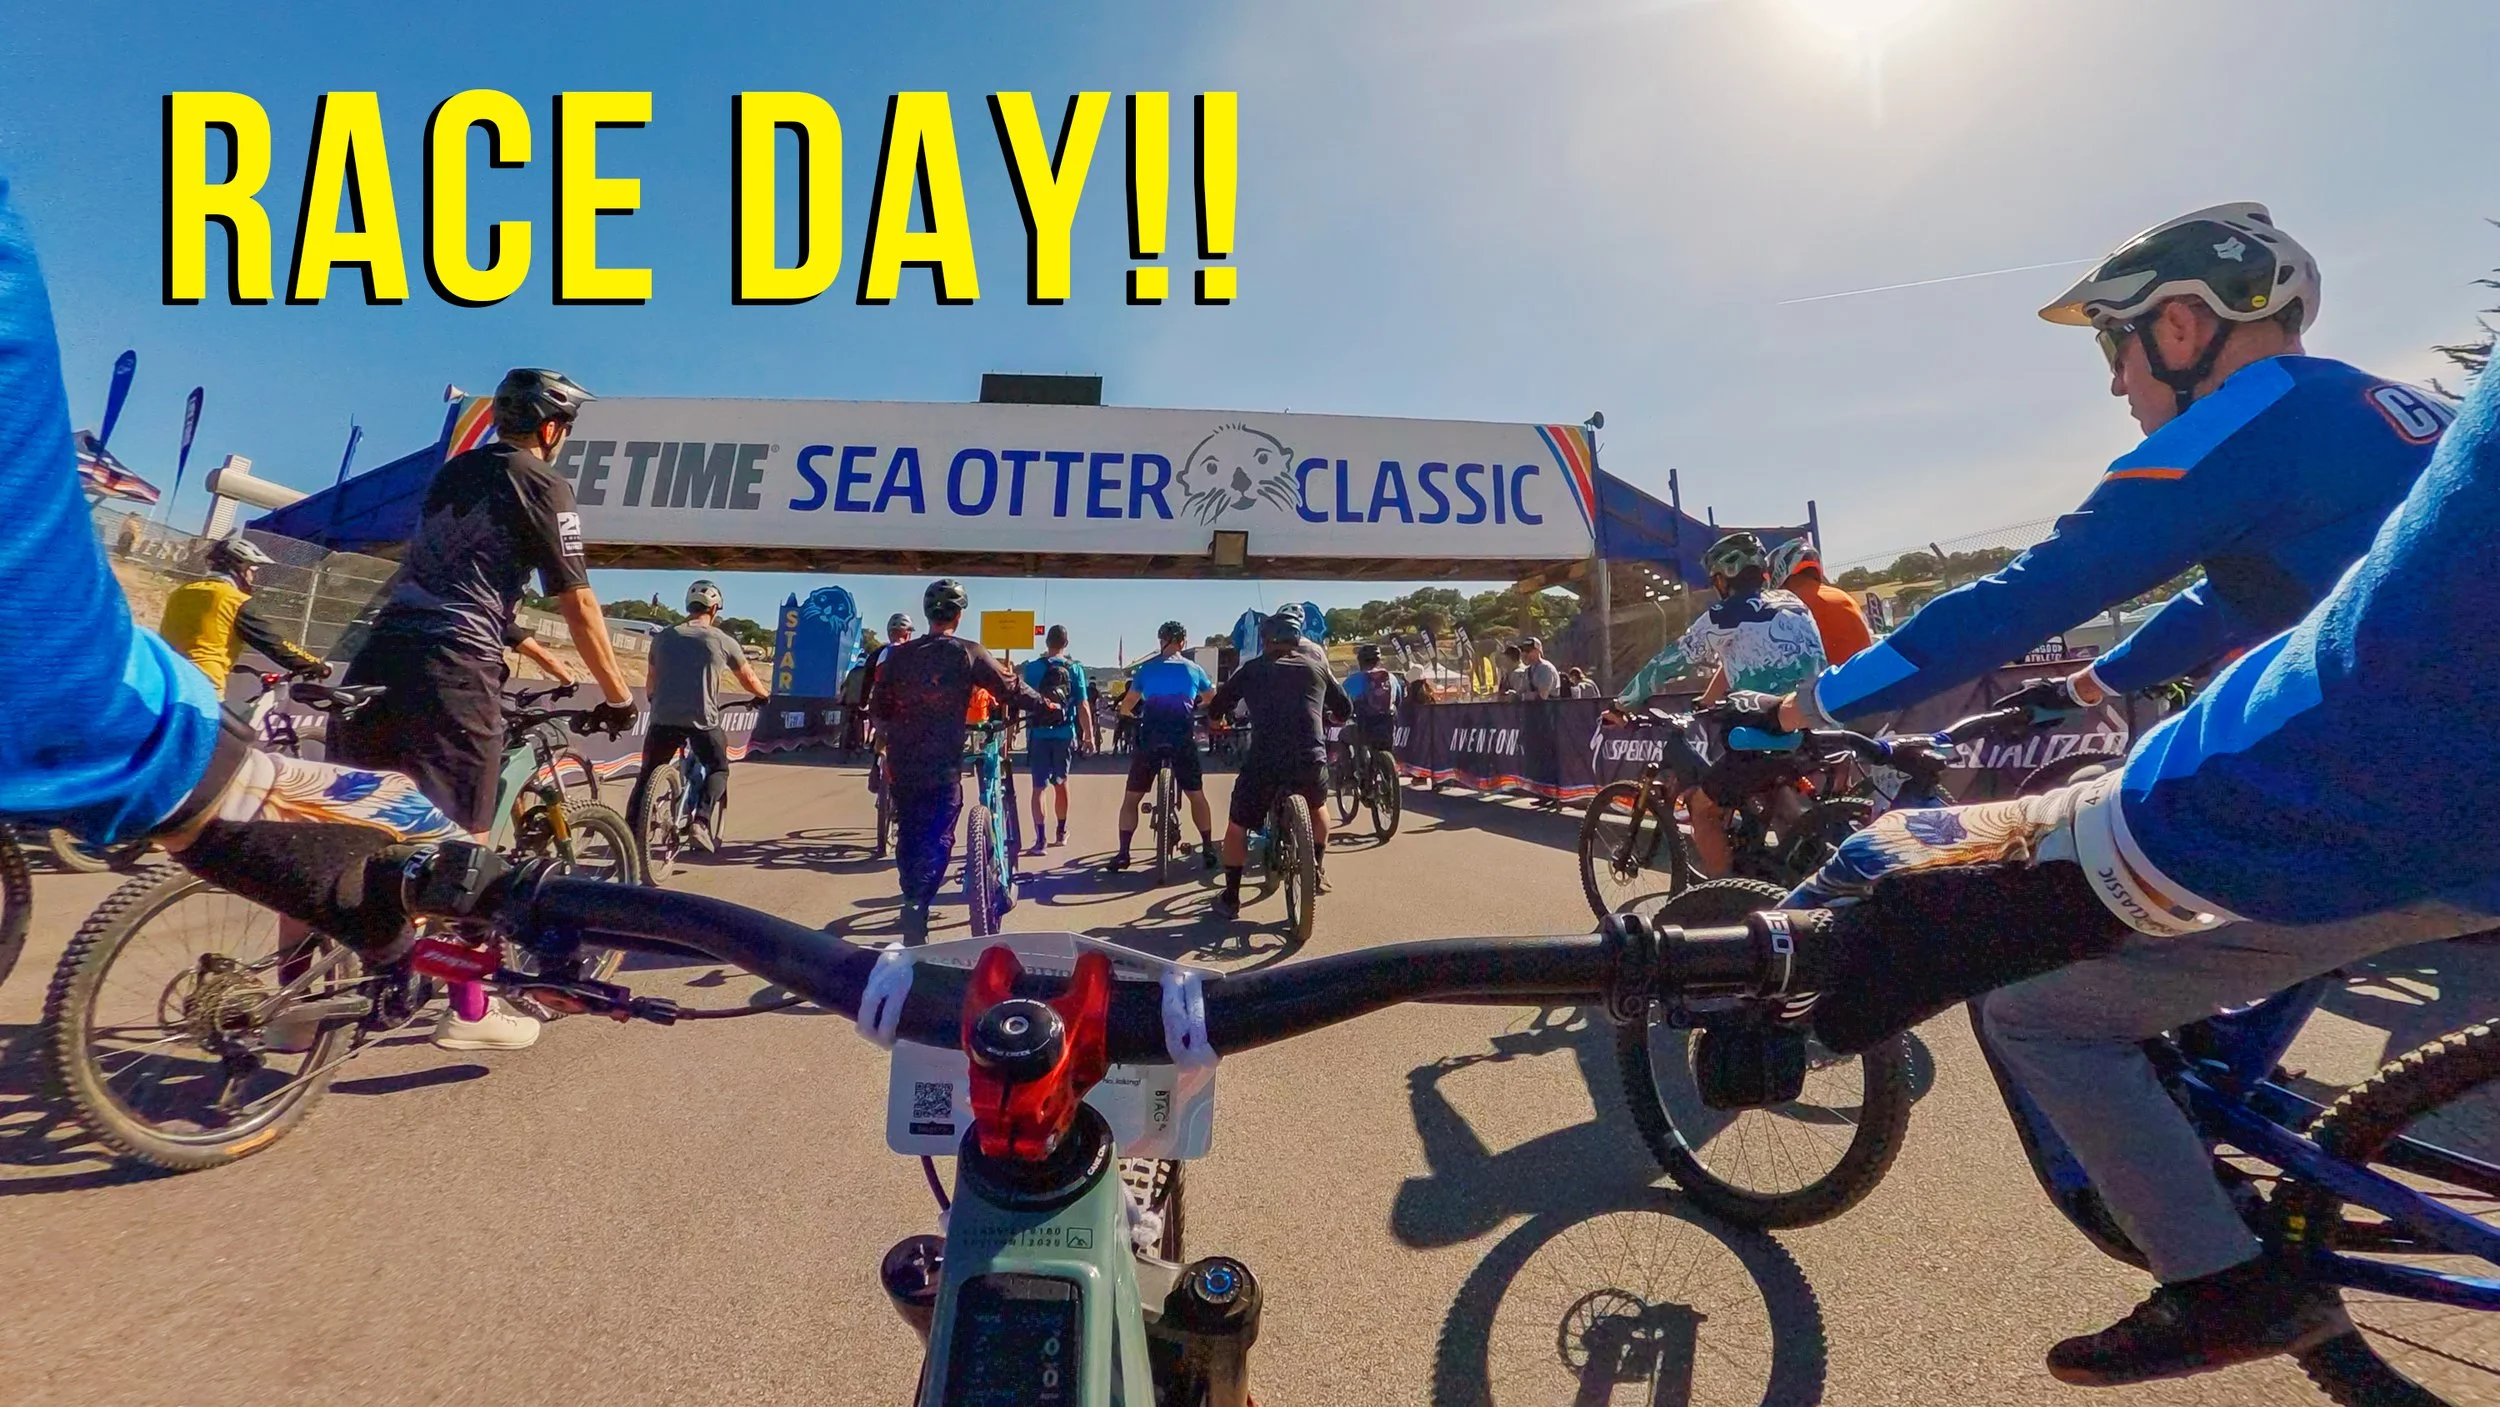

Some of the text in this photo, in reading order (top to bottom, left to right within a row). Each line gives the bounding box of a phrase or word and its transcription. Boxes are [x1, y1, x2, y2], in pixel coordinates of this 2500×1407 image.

[788, 444, 1544, 526] SEA OTTER CLASSIC
[1450, 728, 1519, 756] AVENTON
